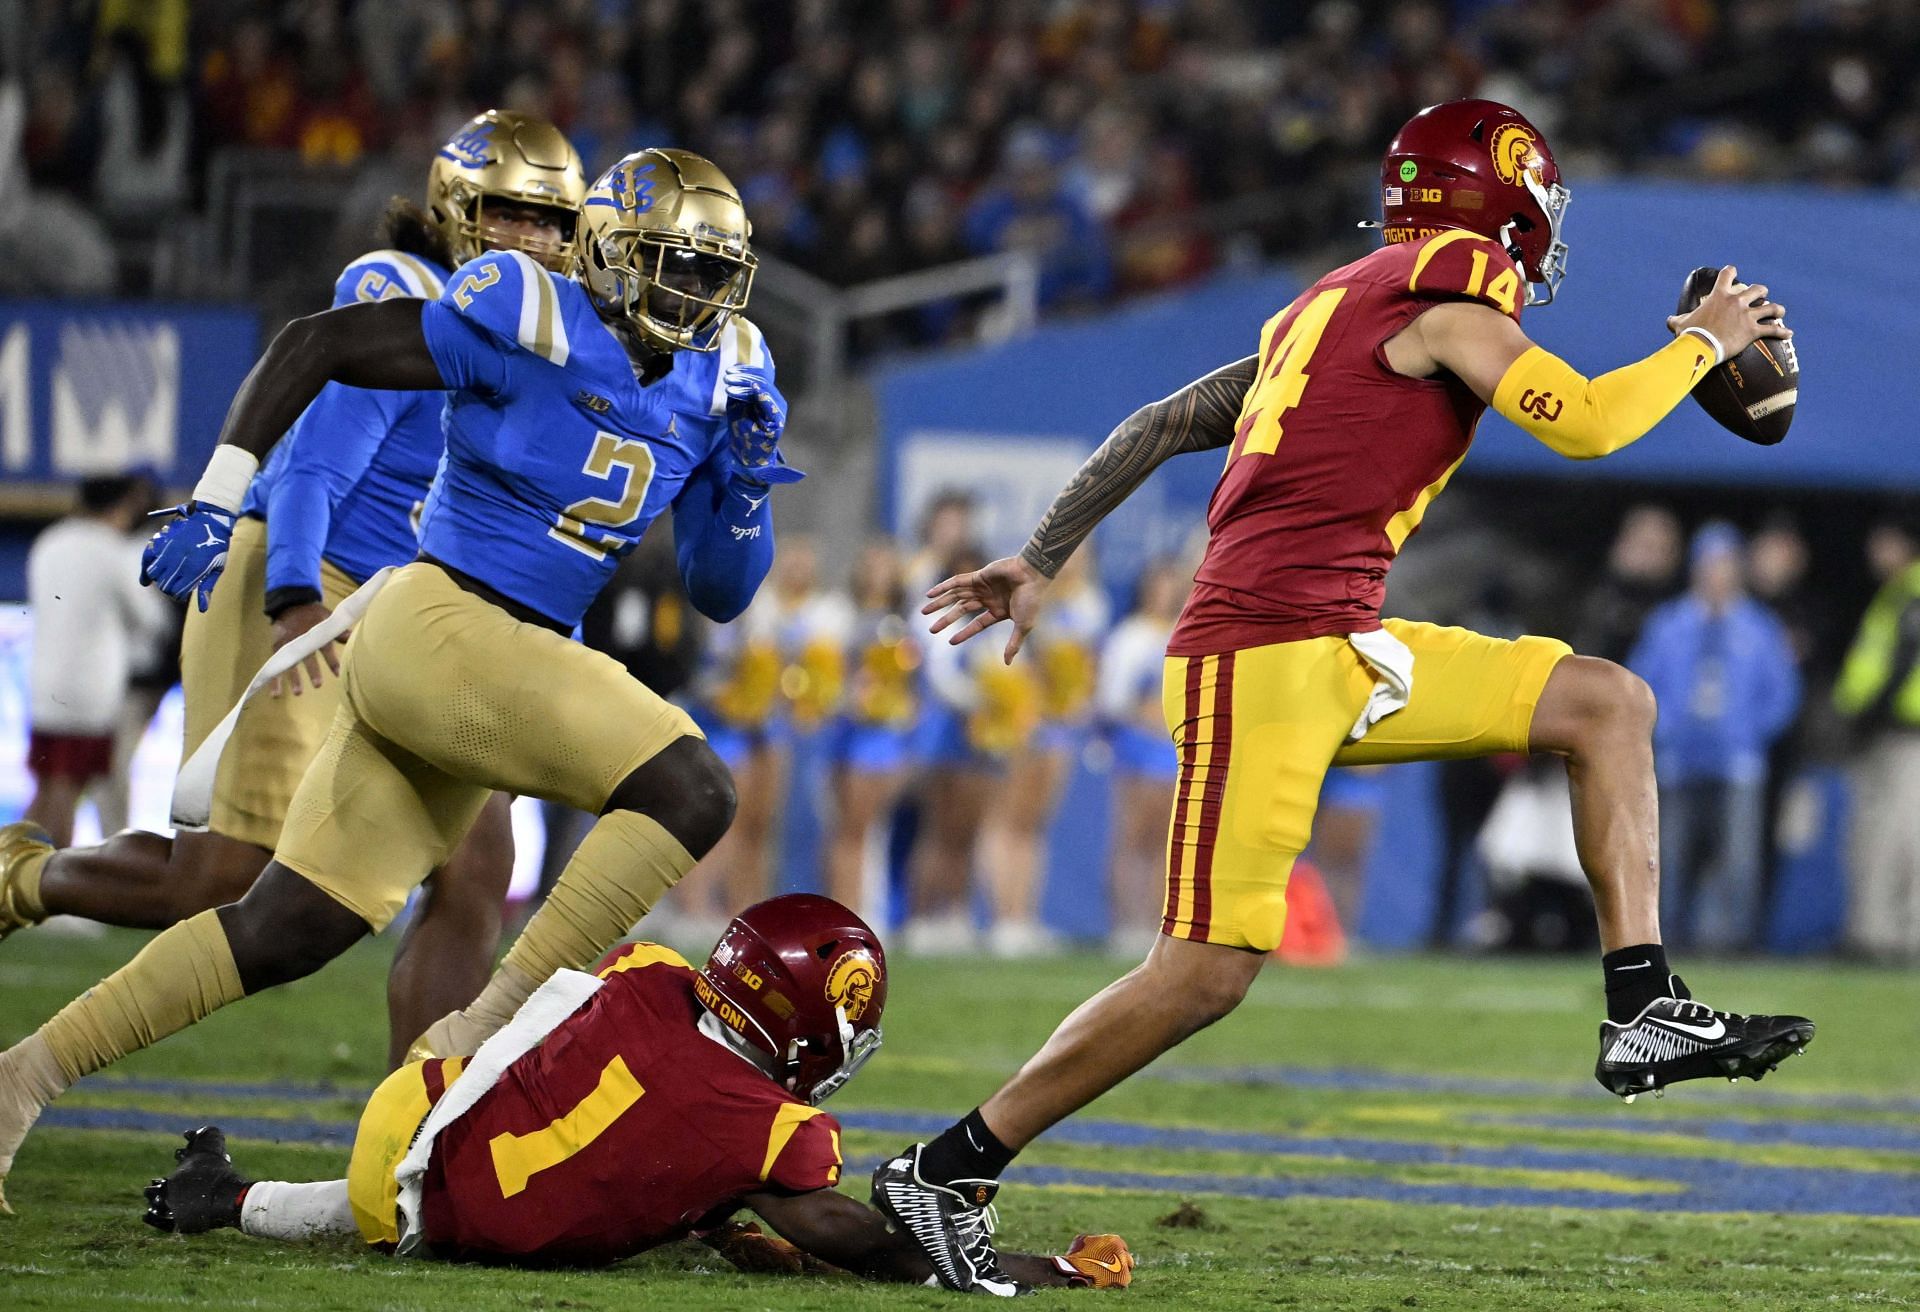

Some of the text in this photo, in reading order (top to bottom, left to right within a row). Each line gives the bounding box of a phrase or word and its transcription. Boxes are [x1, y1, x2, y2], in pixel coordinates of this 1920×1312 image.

[1401, 165, 1416, 176] C2P
[1384, 227, 1415, 244] FIGHT
[452, 263, 501, 312] 2
[1464, 248, 1519, 315] 14
[1232, 286, 1348, 458] 14
[1519, 388, 1563, 422] SC
[547, 430, 656, 562] 2
[694, 975, 747, 1033] FIGHT ON!
[489, 1054, 646, 1199] 1
